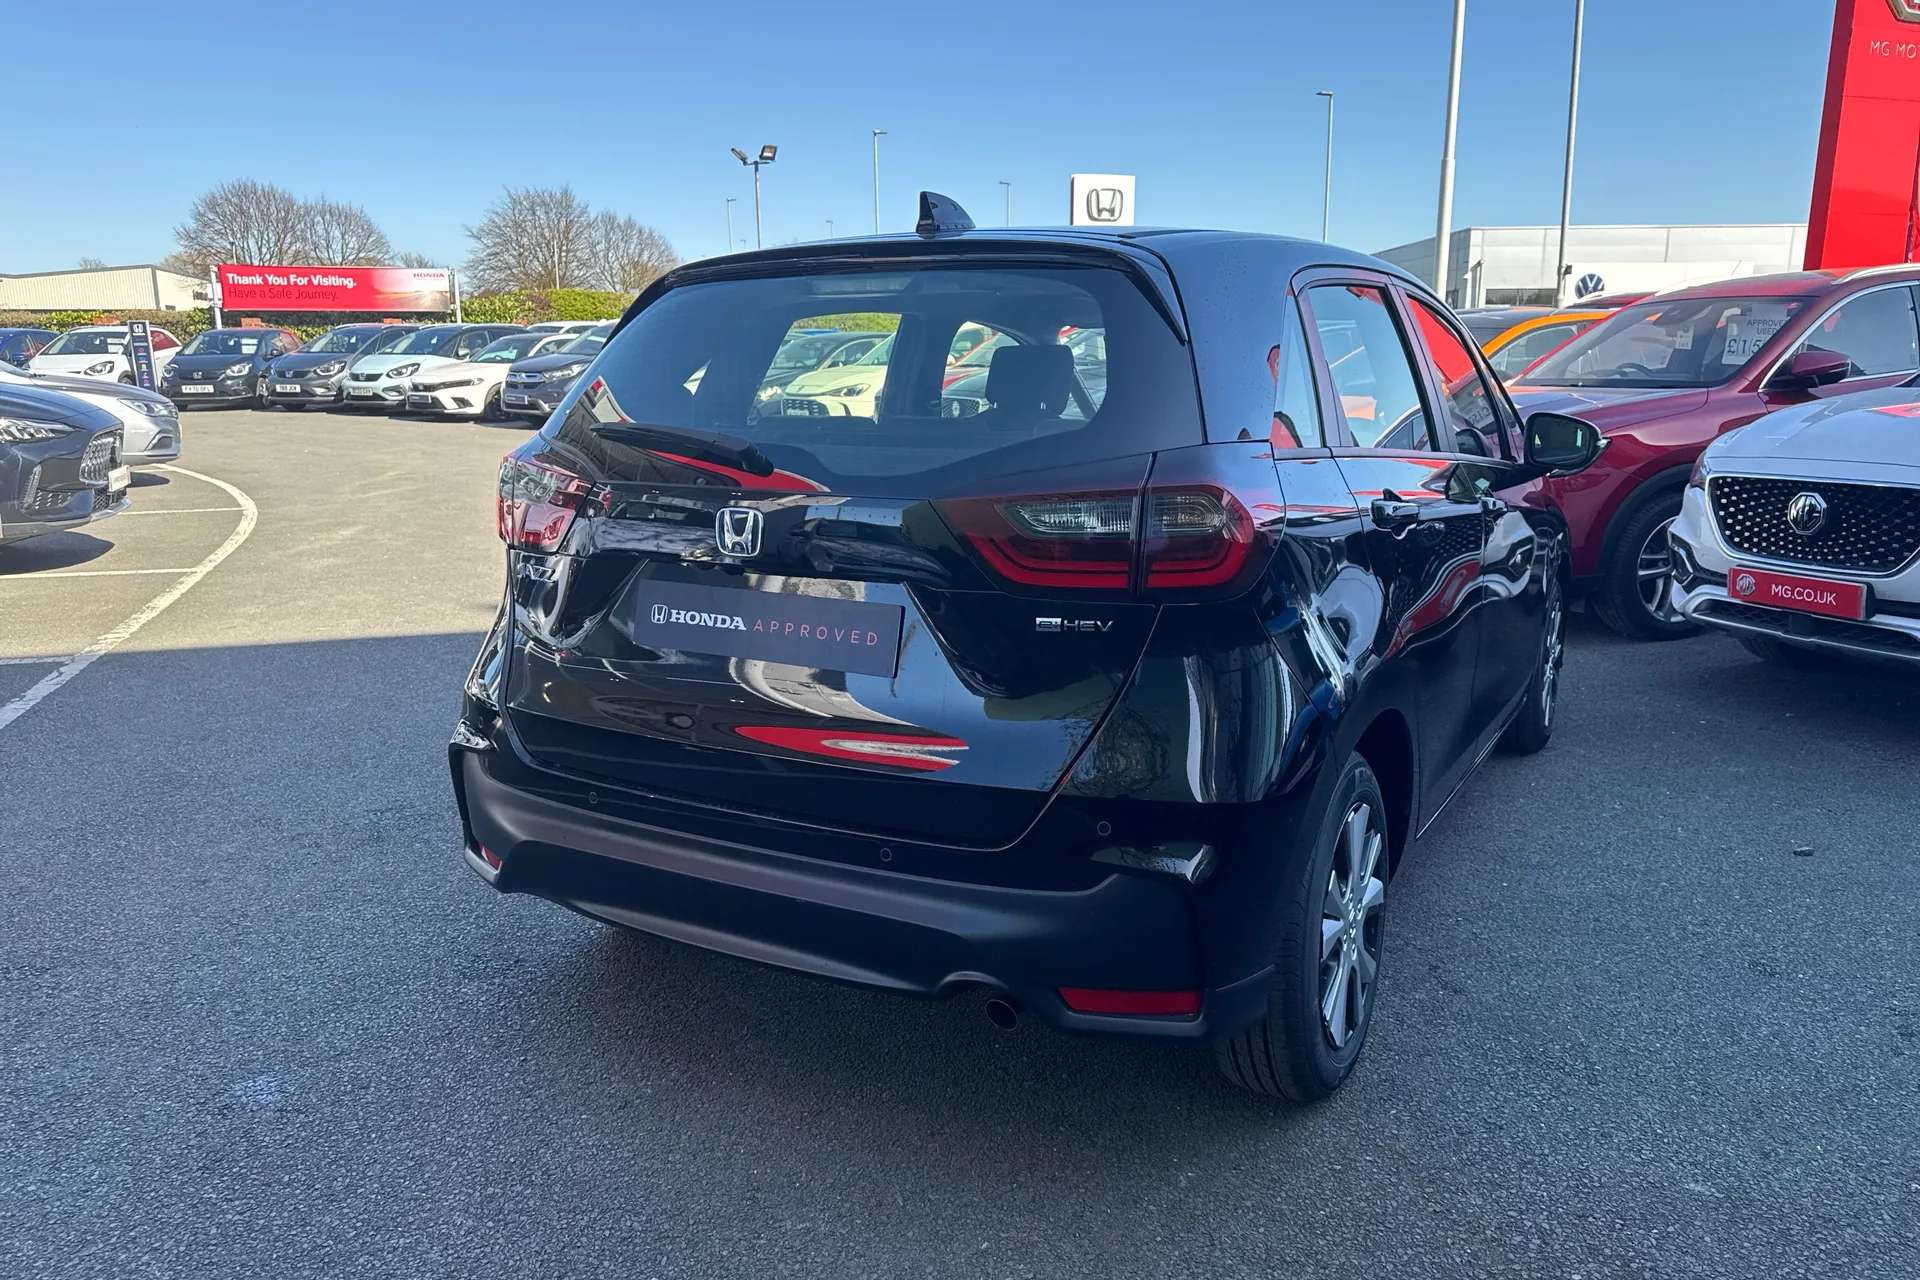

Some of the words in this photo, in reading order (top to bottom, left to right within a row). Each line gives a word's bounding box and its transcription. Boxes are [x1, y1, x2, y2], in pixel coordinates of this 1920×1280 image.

[1870, 40, 1890, 57] MG
[1896, 43, 1920, 59] MO
[226, 273, 264, 285] Thank
[265, 273, 287, 286] You
[289, 274, 309, 286] For
[310, 274, 357, 289] Visiting.
[228, 287, 257, 298] Have
[259, 290, 266, 299] a
[268, 287, 292, 299] Safe
[1727, 338, 1762, 354] £15
[1771, 584, 1837, 606] MG.CO.UK
[669, 608, 747, 631] HONDA
[754, 619, 878, 646] APPROVED
